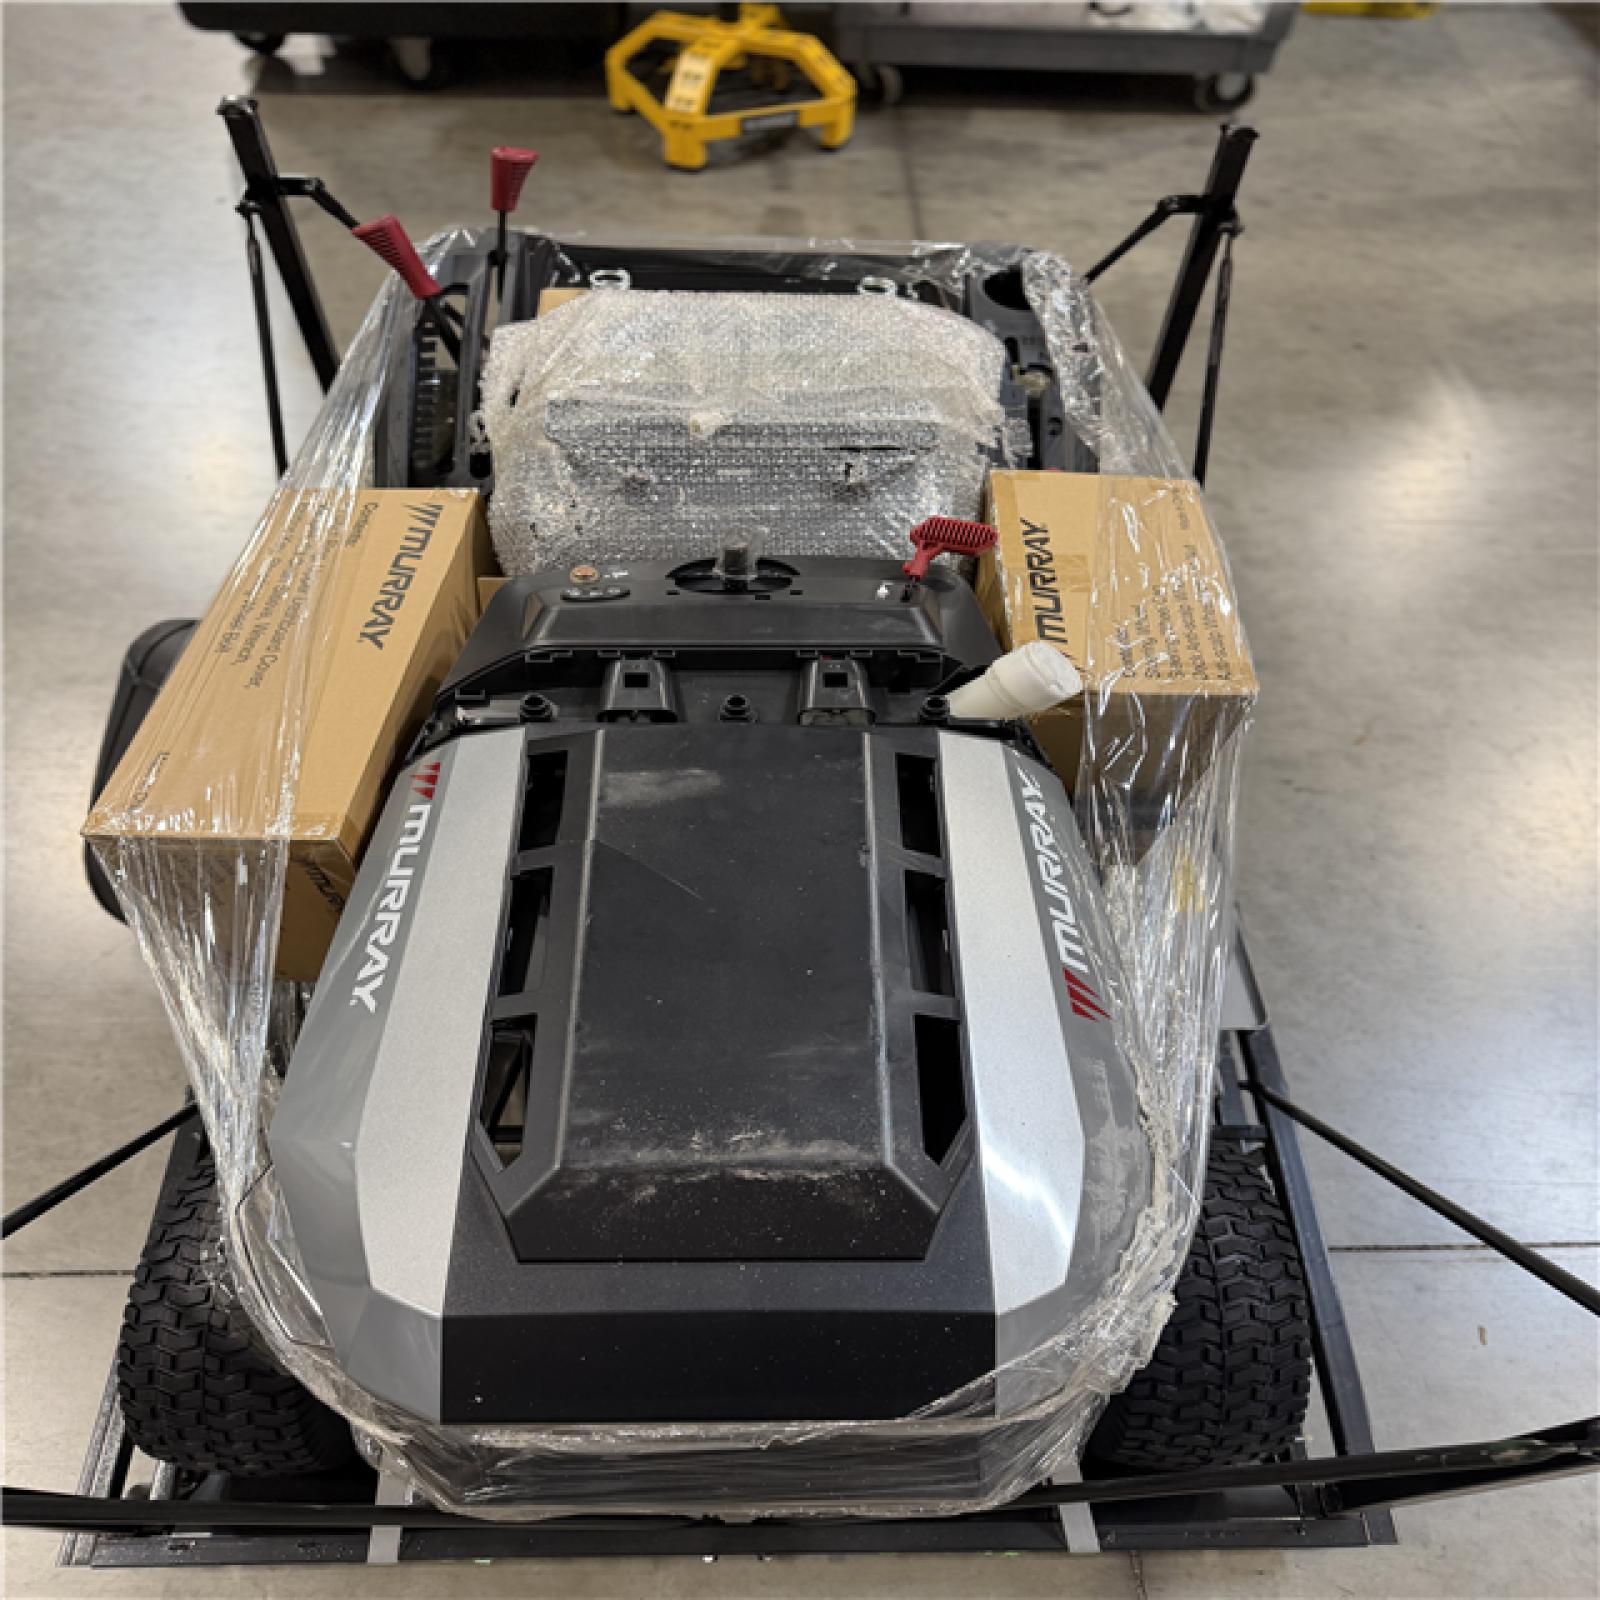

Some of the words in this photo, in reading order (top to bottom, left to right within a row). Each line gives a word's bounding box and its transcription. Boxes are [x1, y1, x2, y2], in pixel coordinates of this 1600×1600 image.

[359, 526, 433, 651] MURRAY
[1020, 516, 1068, 644] MURRAY
[244, 654, 279, 689] Cover,
[350, 803, 432, 1014] MURRAY
[1016, 767, 1090, 974] MURRAY
